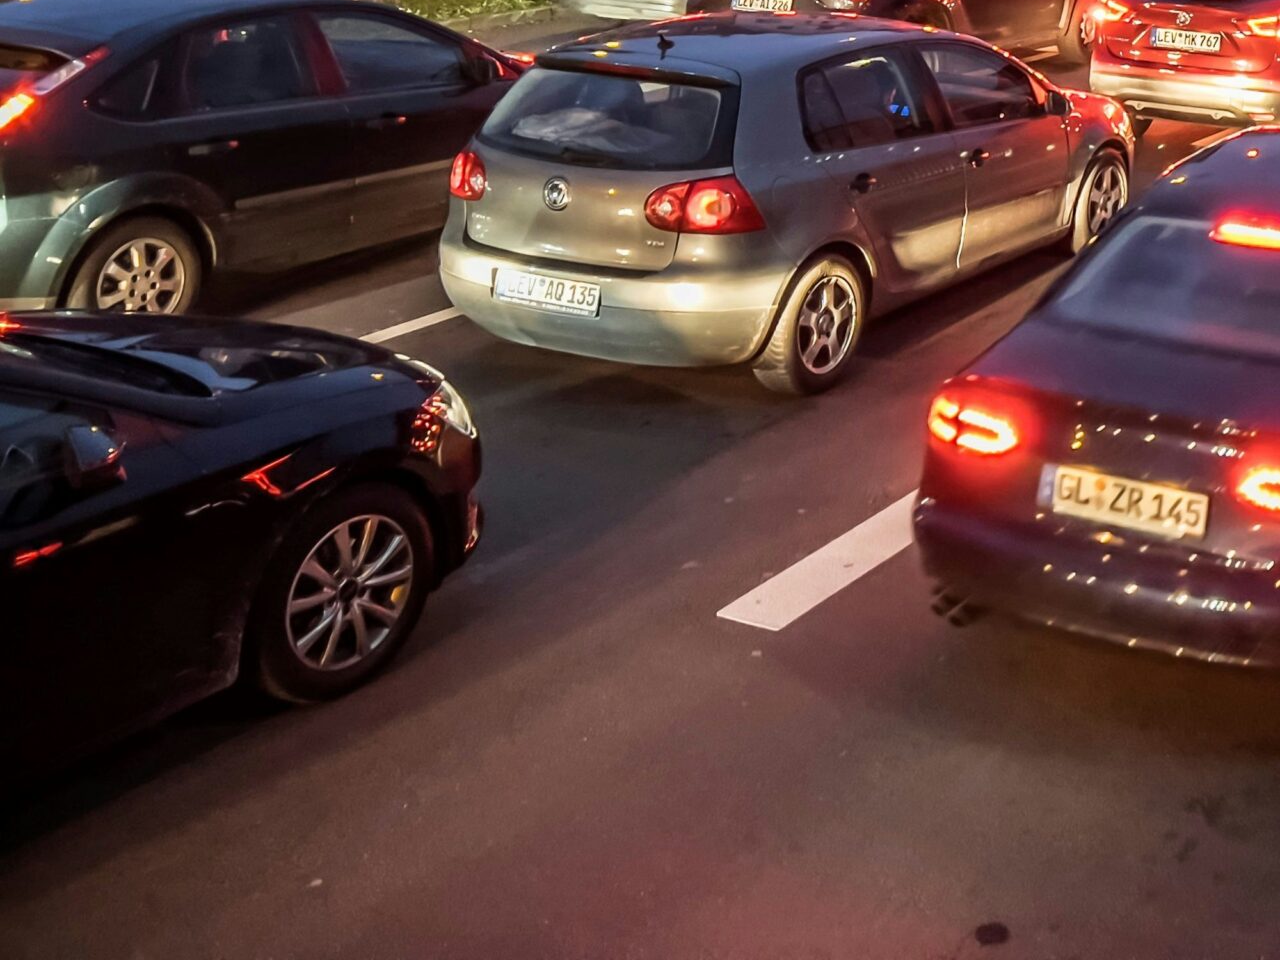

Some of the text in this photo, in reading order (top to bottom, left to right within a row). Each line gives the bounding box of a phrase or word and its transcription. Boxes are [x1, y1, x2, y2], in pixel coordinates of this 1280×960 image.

[1157, 31, 1220, 49] LEV MK 767
[507, 274, 538, 297] LEV
[544, 278, 565, 301] AQ
[569, 283, 598, 307] 135
[1057, 473, 1202, 527] GL ZR 145
